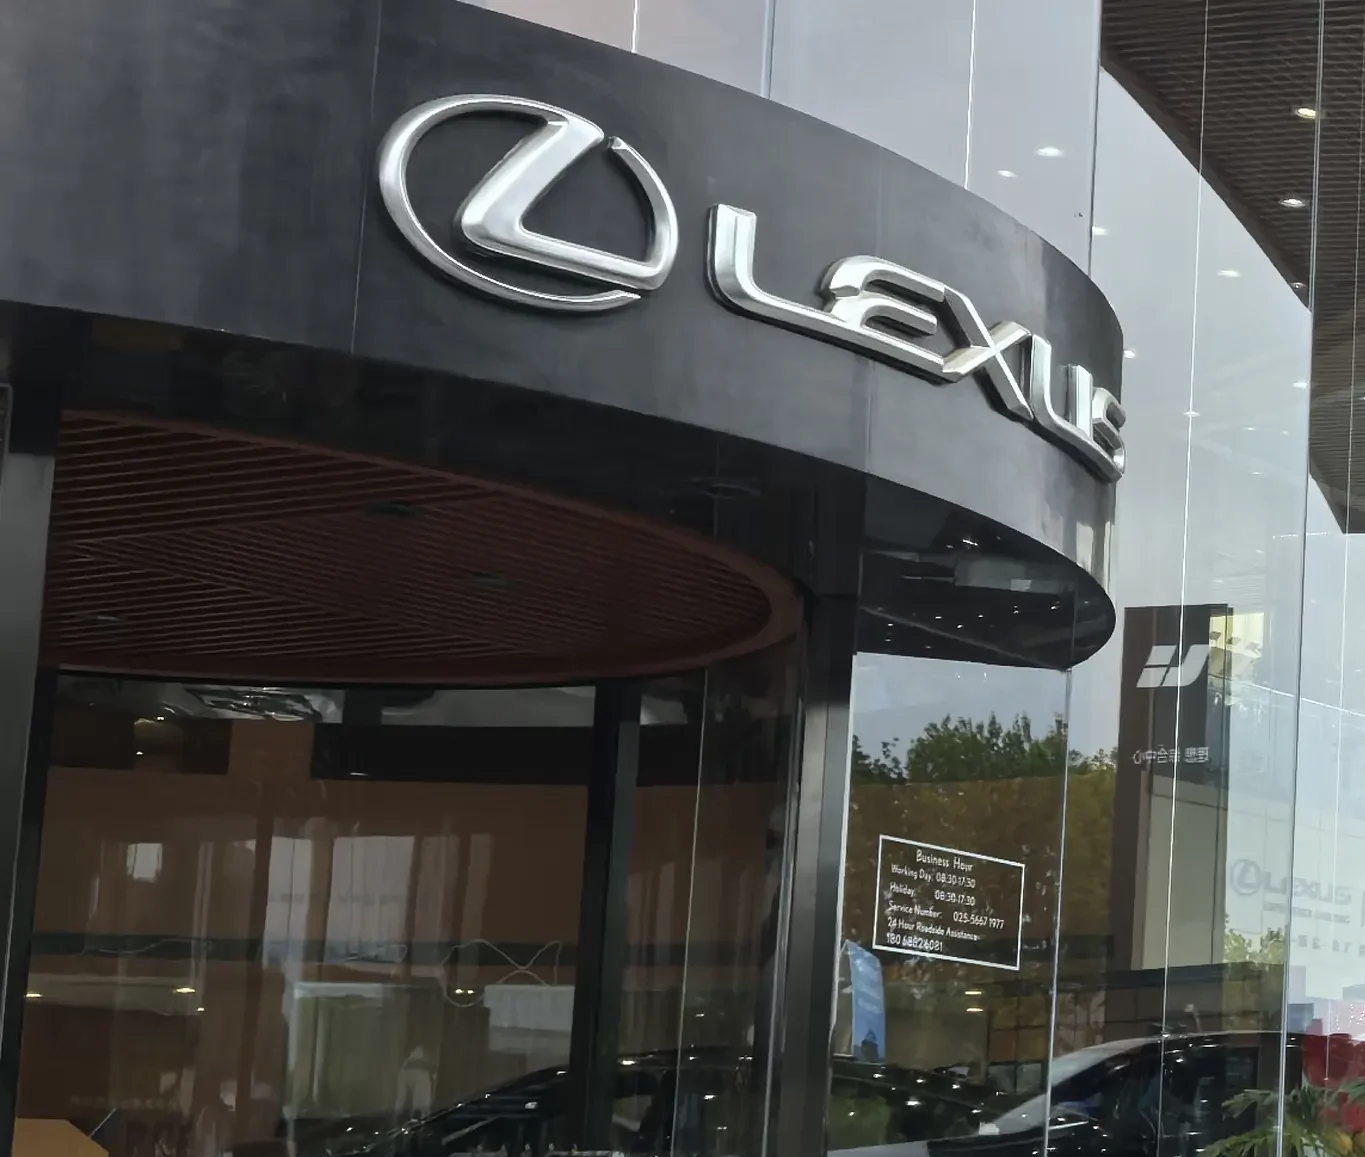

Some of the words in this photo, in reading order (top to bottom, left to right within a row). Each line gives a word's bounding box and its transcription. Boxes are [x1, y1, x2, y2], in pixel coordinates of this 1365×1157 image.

[707, 203, 1127, 482] LEXUS
[916, 849, 950, 868] Business
[953, 856, 974, 872] Hour
[891, 864, 917, 880] Working
[888, 900, 913, 915] Service
[898, 919, 915, 931] Hour
[916, 922, 945, 937] Roadside
